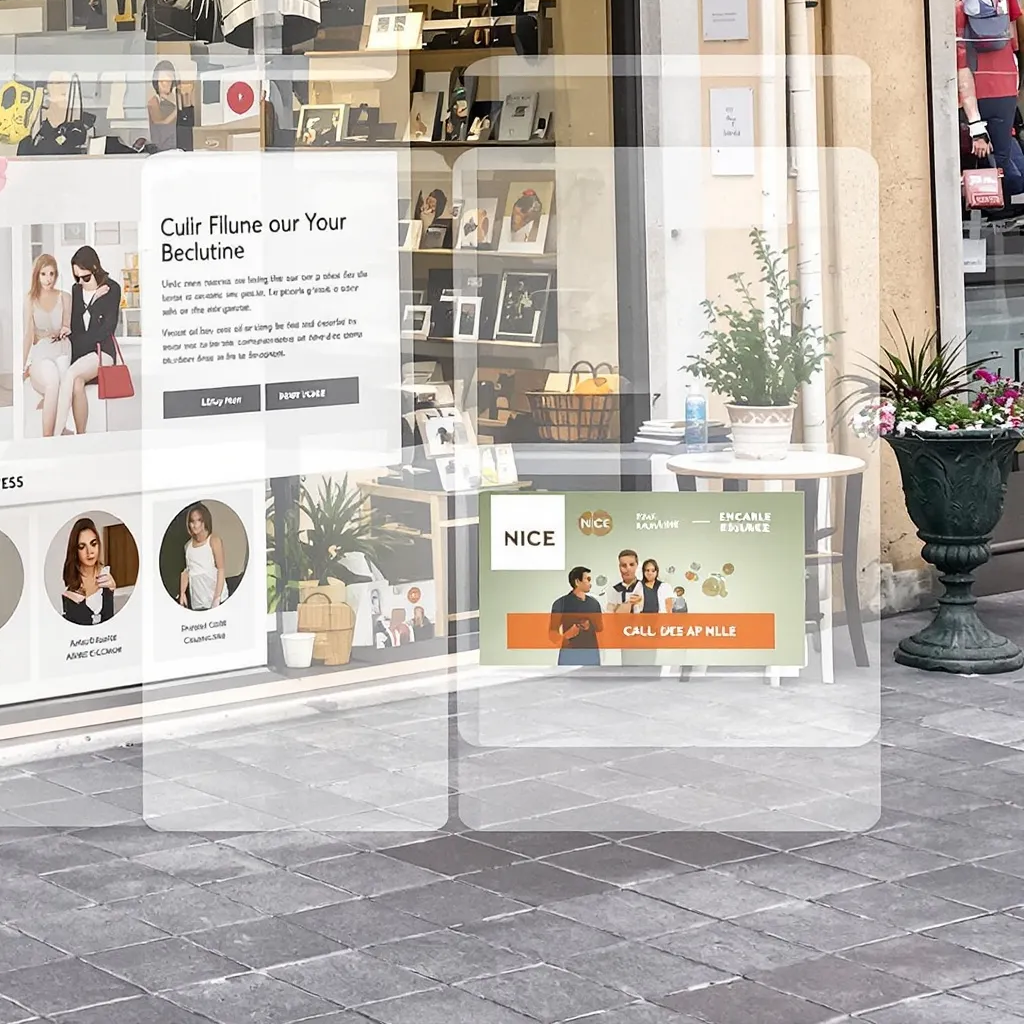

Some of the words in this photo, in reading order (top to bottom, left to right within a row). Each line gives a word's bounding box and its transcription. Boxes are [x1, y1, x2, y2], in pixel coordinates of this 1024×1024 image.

[269, 218, 300, 233] our
[304, 212, 347, 231] Your
[161, 241, 246, 262] Beclutine
[504, 530, 556, 546] NICE
